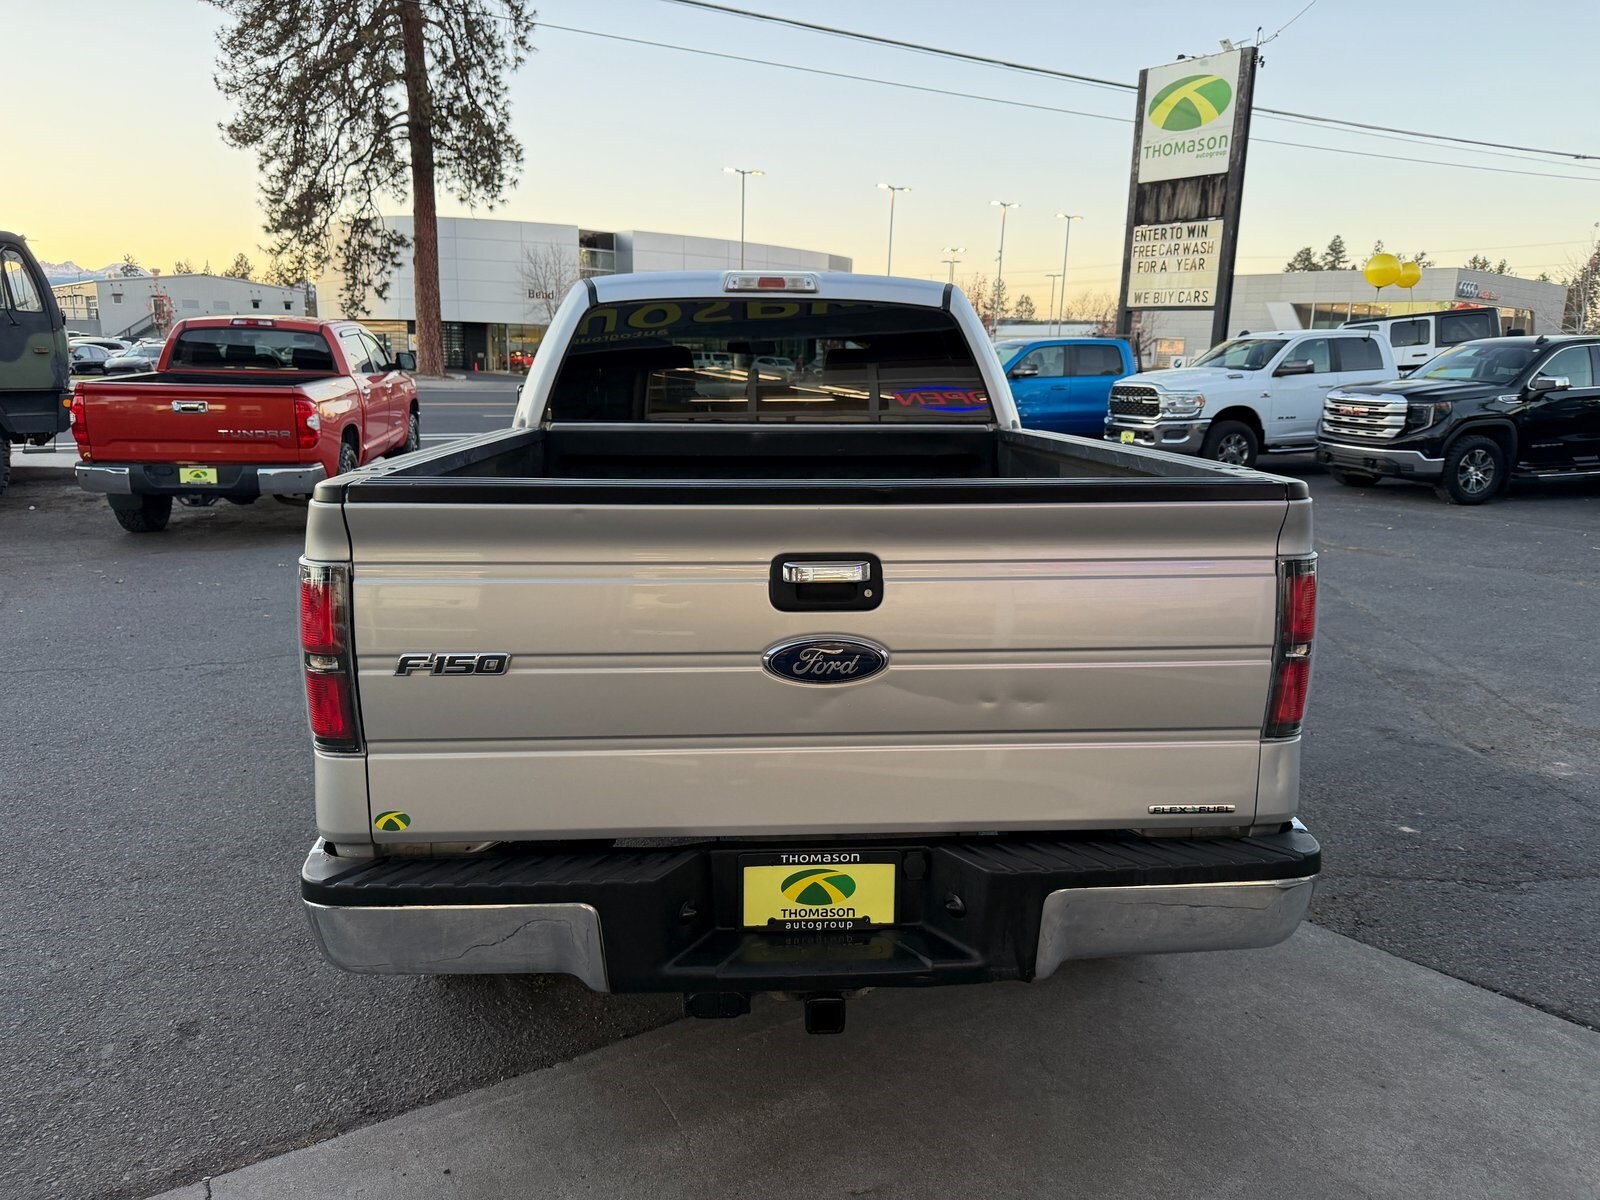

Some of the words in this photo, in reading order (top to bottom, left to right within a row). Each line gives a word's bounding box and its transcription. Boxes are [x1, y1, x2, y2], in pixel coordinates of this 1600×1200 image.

[1144, 134, 1228, 160] THOMason
[1195, 149, 1227, 159] autogroup
[1134, 227, 1167, 243] ENTER
[1169, 226, 1183, 240] TO
[1186, 224, 1208, 239] WIN
[1132, 244, 1157, 258] FREE
[1158, 243, 1180, 257] CAR
[1182, 241, 1214, 256] WASH
[1137, 260, 1157, 274] FOR
[1159, 259, 1167, 273] A
[1176, 257, 1206, 272] YEAR
[1134, 290, 1150, 305] WE
[1152, 290, 1175, 305] BUY
[1177, 289, 1209, 304] CARS
[217, 429, 291, 439] TUNDRA
[393, 652, 512, 677] F-150
[791, 647, 860, 675] Ford
[1152, 806, 1188, 814] FLEX
[1197, 805, 1235, 814] FUEL
[780, 853, 860, 863] THOMason
[781, 908, 856, 918] THOMason
[785, 920, 853, 931] autogroup
